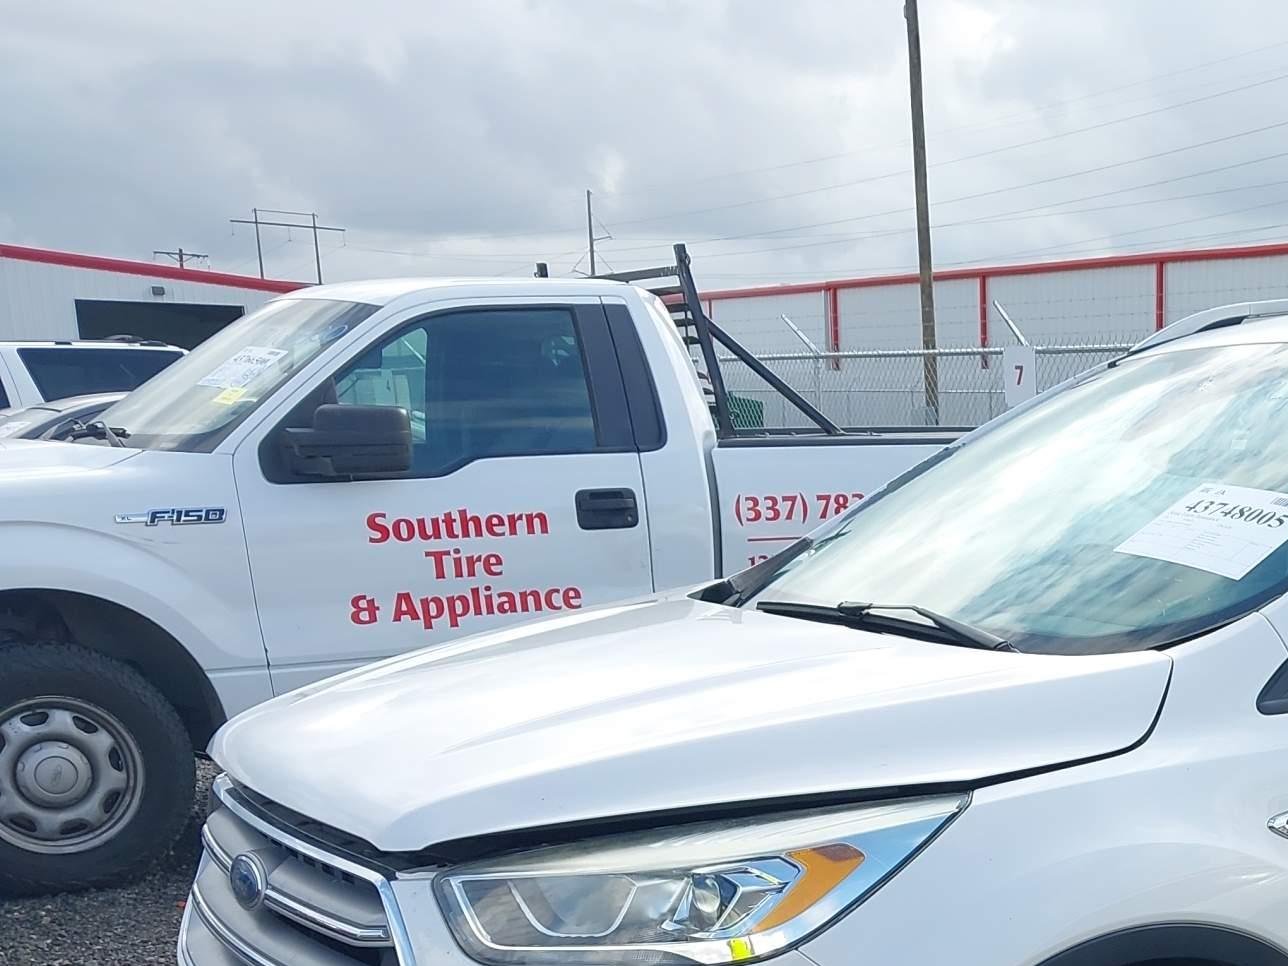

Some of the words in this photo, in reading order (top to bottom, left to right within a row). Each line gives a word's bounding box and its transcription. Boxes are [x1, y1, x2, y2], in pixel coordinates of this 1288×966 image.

[1014, 365, 1024, 386] 7
[147, 508, 225, 525] F-150
[366, 509, 550, 544] Southern
[735, 493, 808, 527] (337)
[424, 547, 504, 580] Tire
[350, 595, 380, 625] &
[392, 585, 583, 630] Appliance
